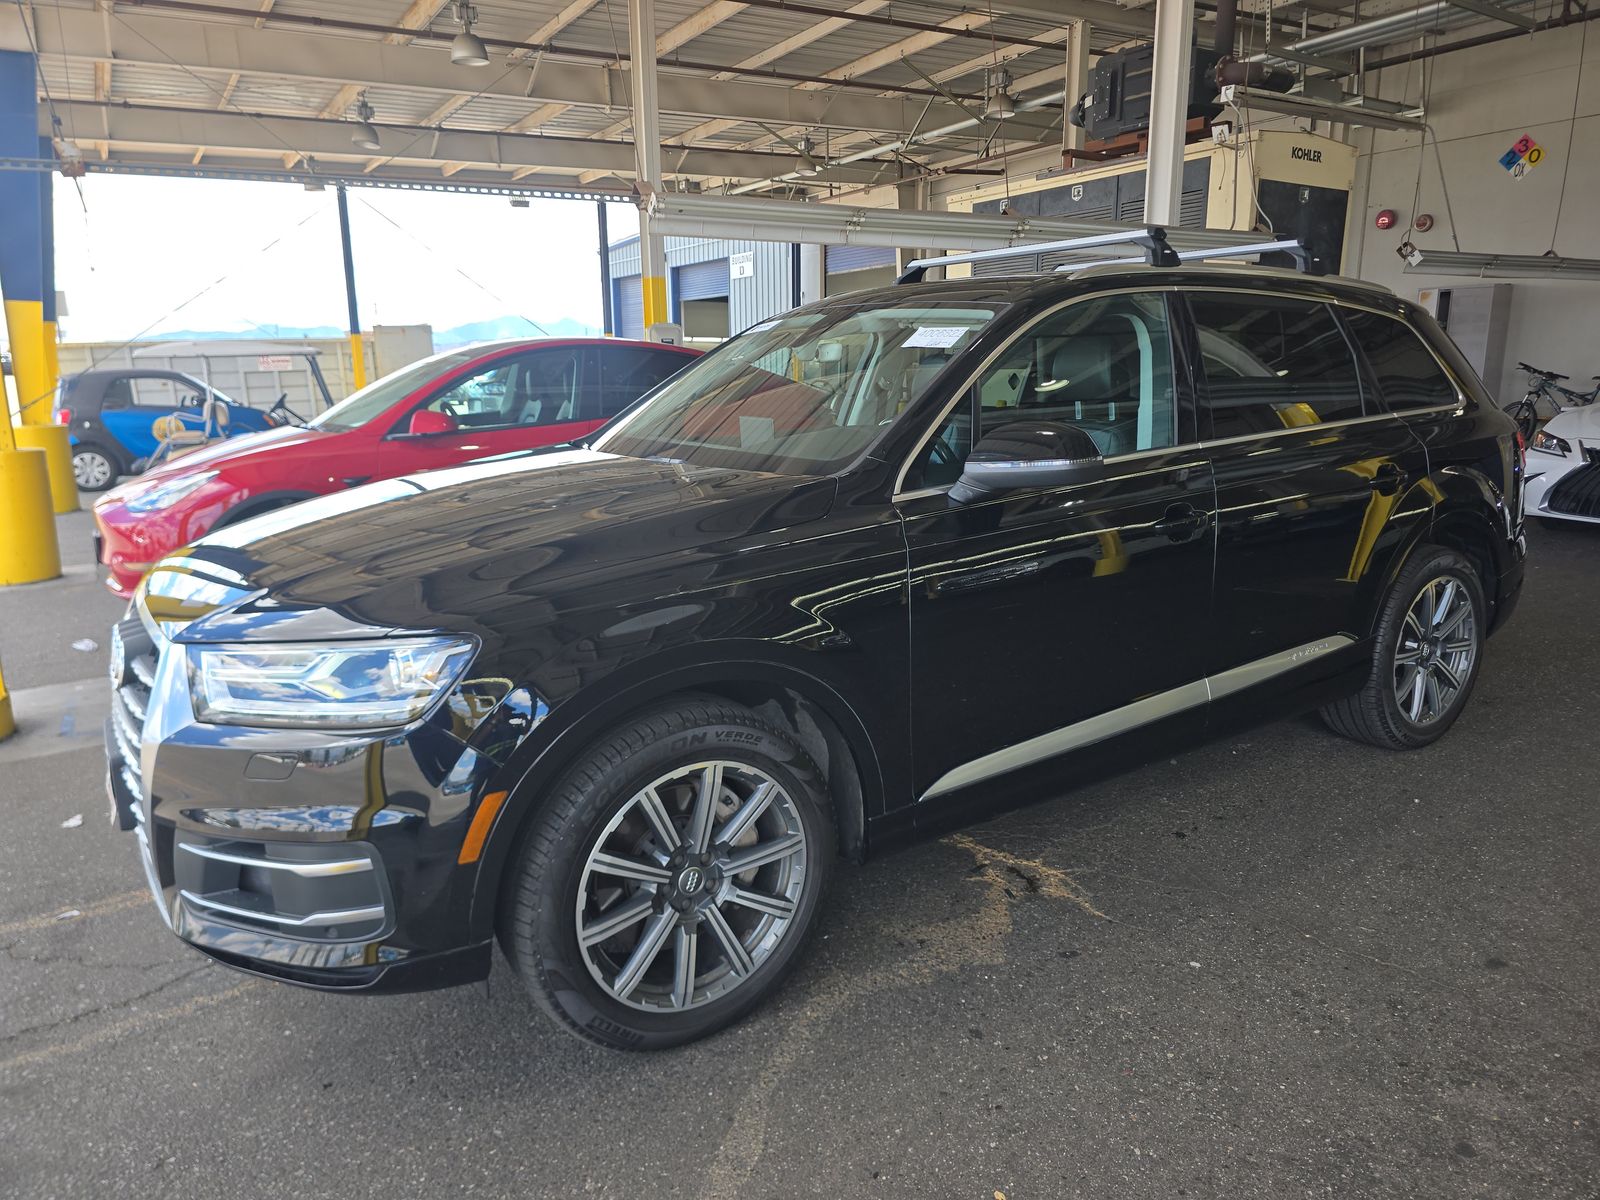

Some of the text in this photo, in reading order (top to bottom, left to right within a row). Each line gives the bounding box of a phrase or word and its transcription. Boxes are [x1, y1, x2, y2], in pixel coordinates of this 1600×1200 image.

[1518, 138, 1529, 153] 3
[1291, 146, 1322, 163] KOHLER
[1505, 148, 1541, 166] 2 0
[1513, 162, 1527, 178] OX
[731, 253, 753, 266] BUILDING
[739, 265, 745, 276] D
[715, 730, 763, 743] VERDE
